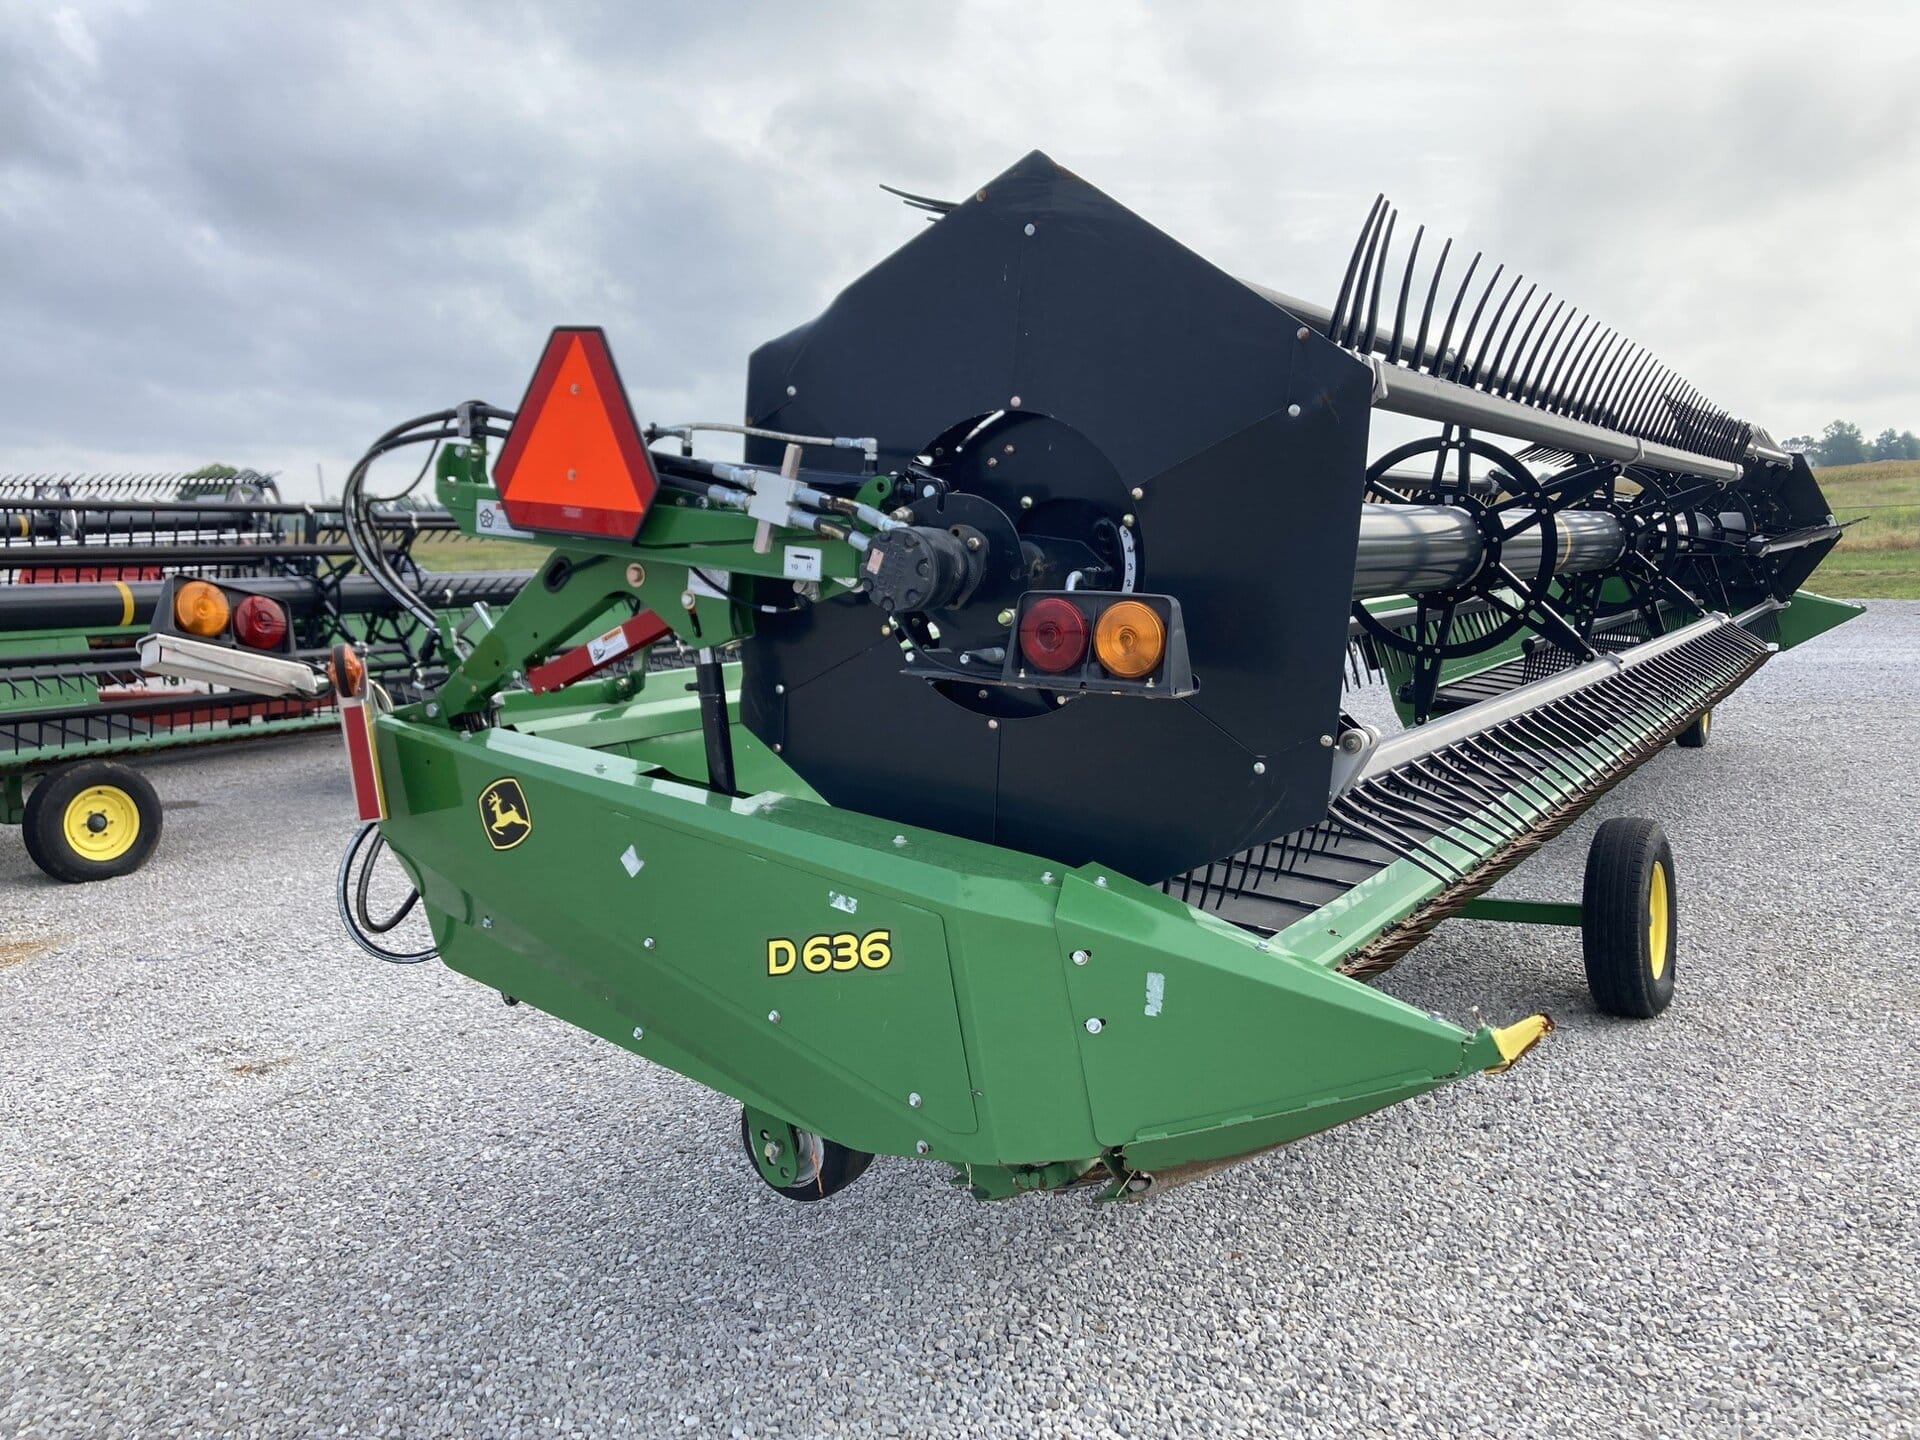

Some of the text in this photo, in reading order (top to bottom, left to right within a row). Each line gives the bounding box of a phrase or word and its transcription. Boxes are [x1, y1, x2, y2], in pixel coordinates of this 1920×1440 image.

[1122, 529, 1129, 538] 5
[1127, 545, 1134, 553] 4
[1127, 562, 1133, 571] 3
[1125, 579, 1131, 587] 2
